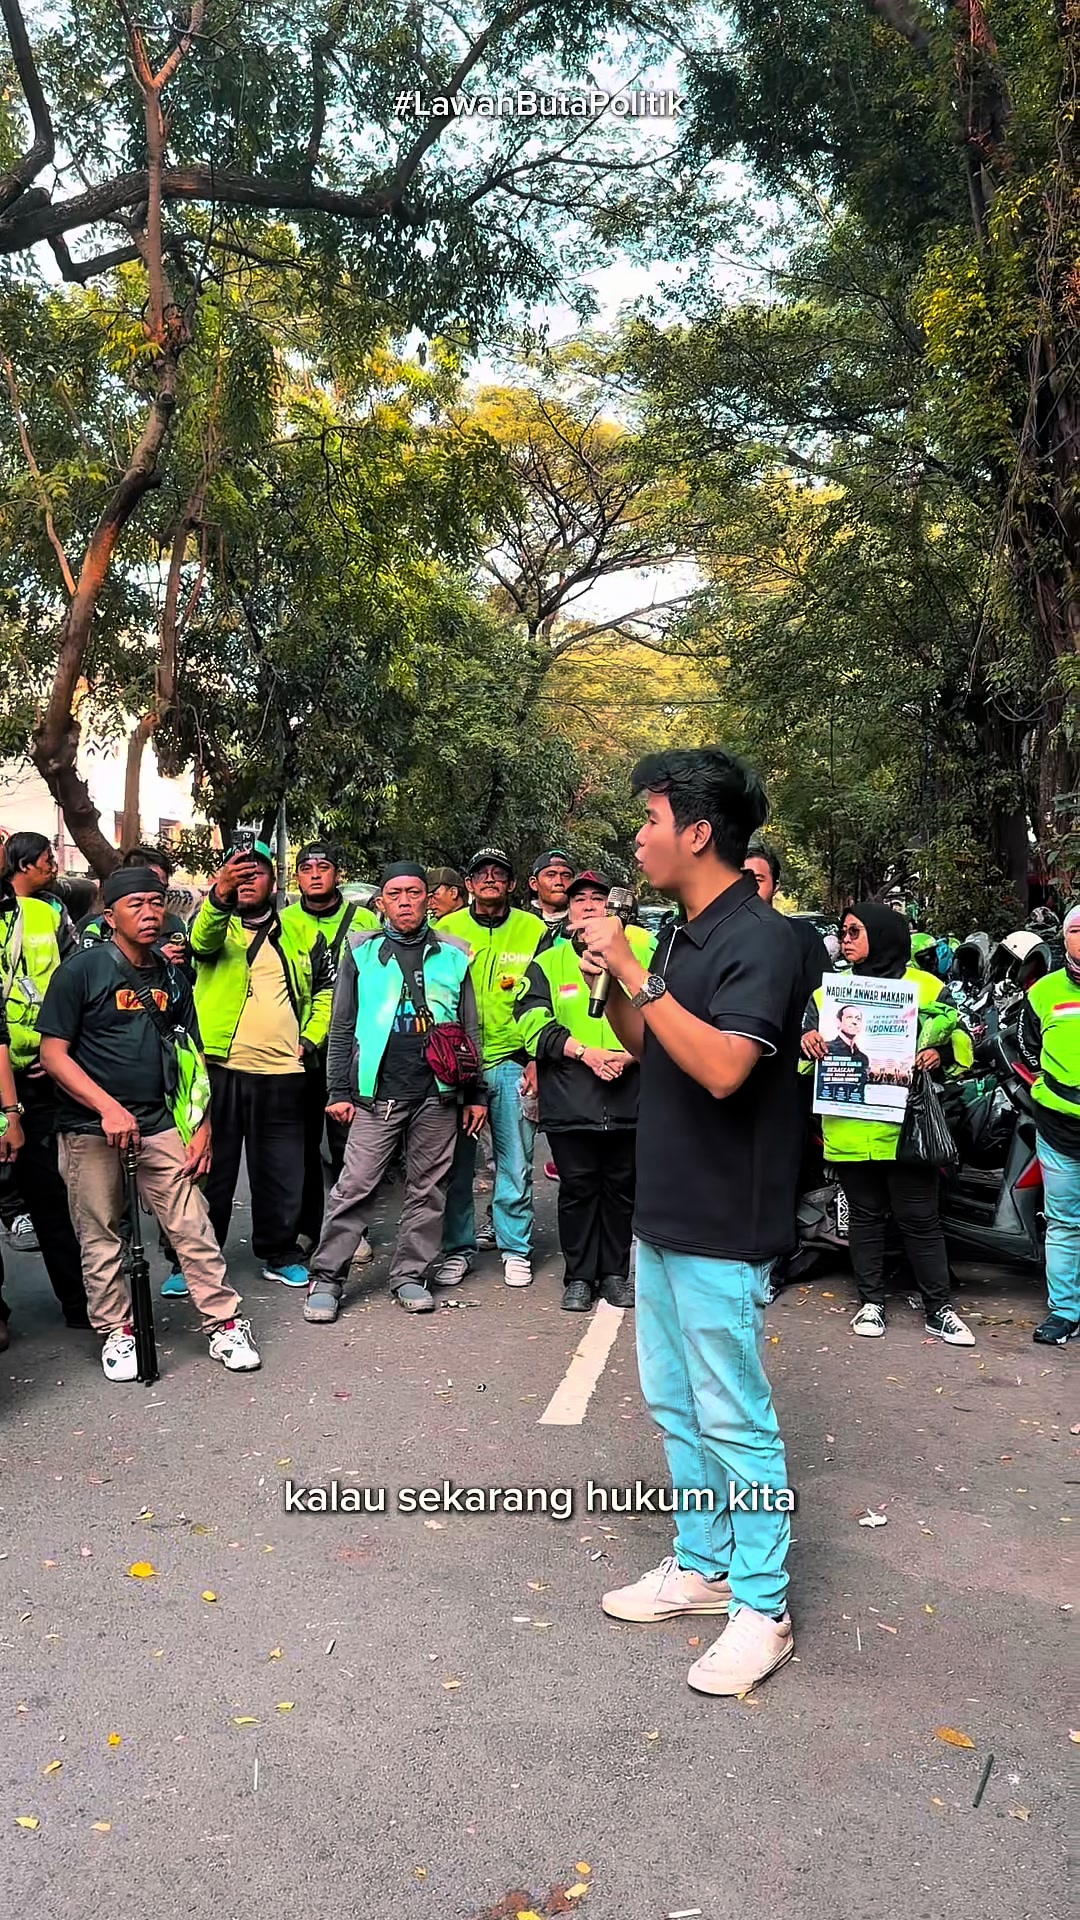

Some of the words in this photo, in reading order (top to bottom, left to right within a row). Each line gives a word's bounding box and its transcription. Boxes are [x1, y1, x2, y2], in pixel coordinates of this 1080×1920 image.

[826, 985, 853, 998] NADIEM
[853, 988, 879, 1001] ANWAR
[880, 991, 914, 1004] MAKARIM
[865, 1024, 909, 1033] INDONESIA!
